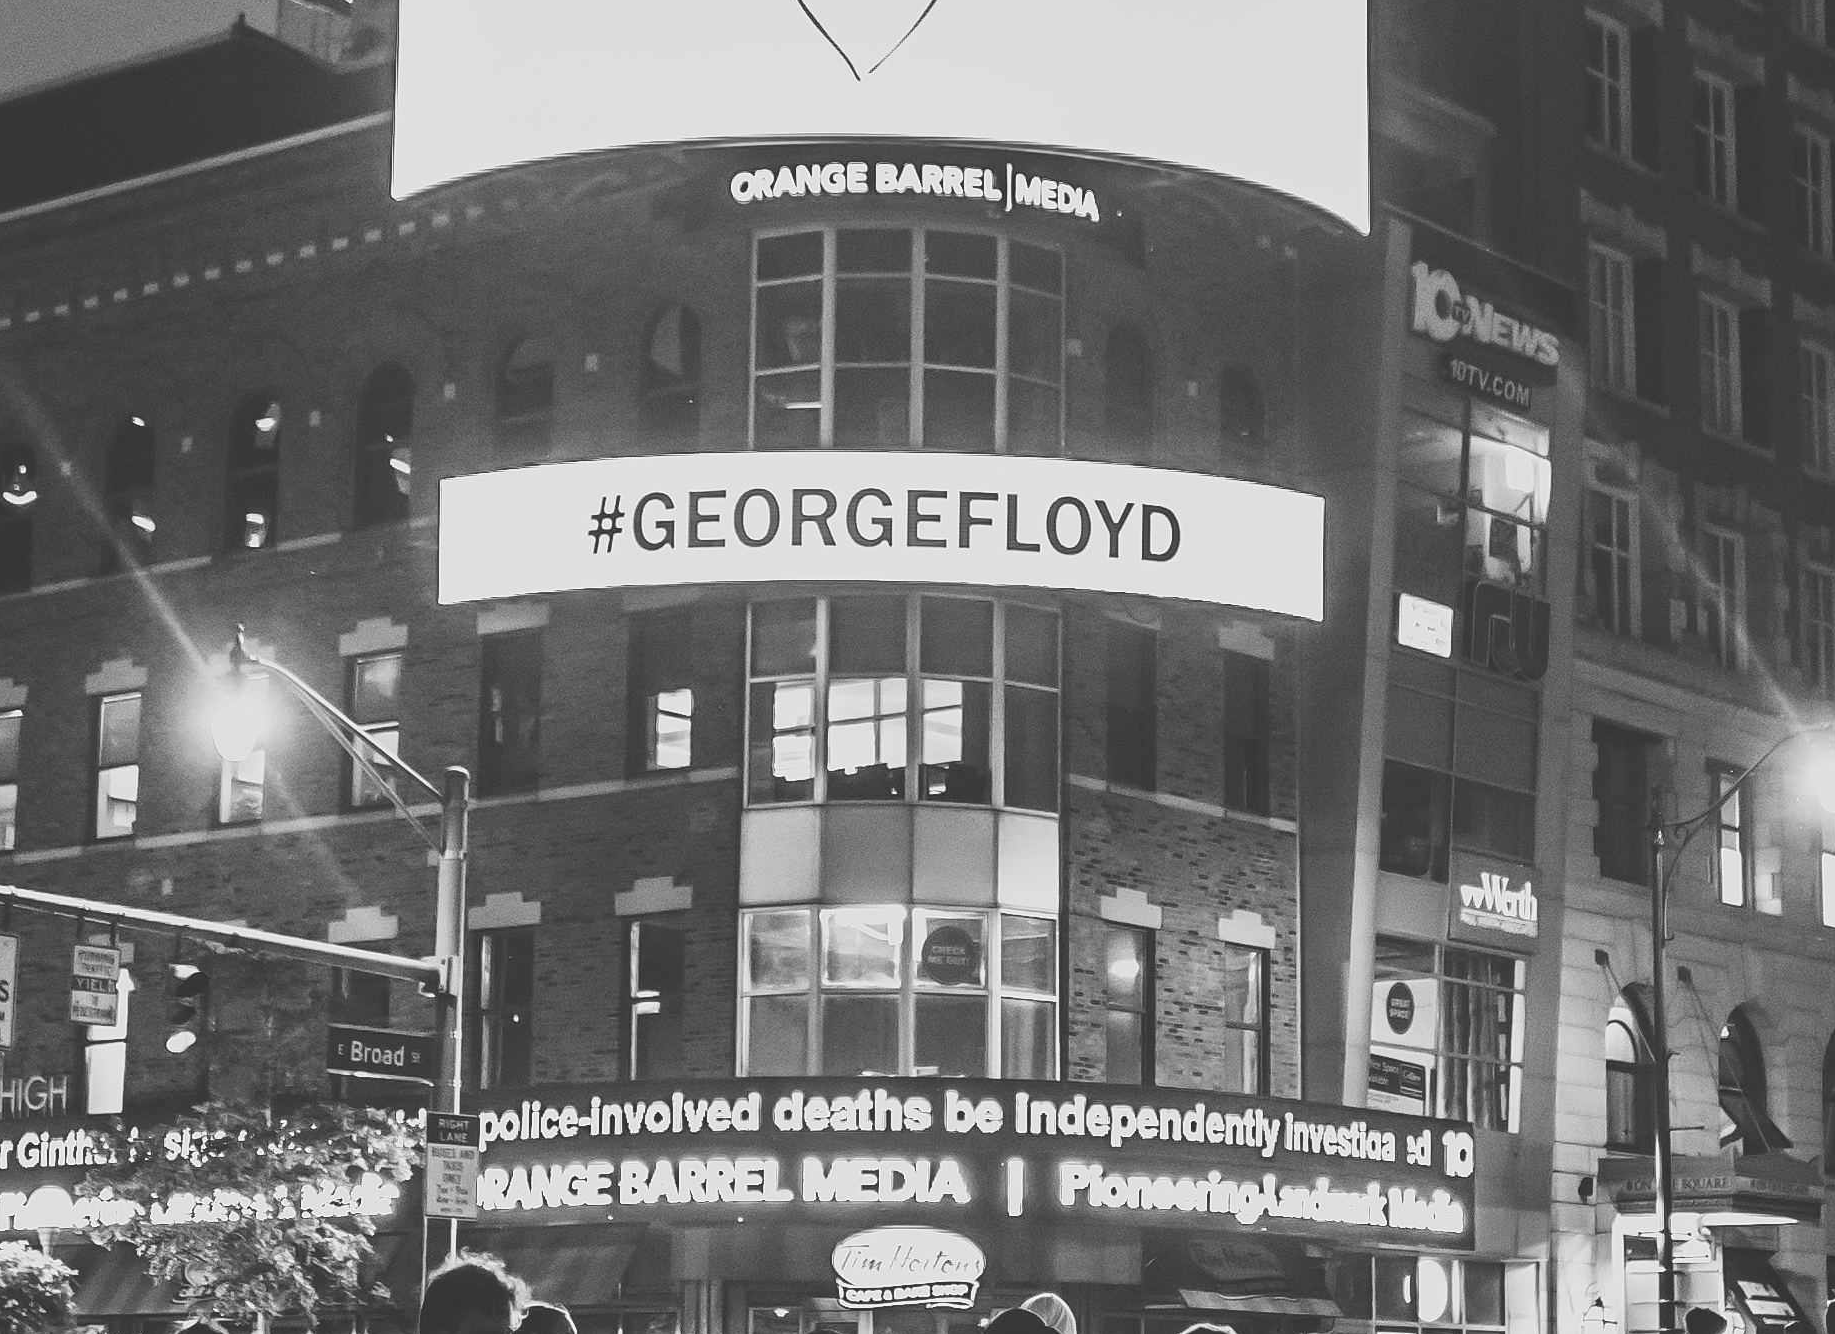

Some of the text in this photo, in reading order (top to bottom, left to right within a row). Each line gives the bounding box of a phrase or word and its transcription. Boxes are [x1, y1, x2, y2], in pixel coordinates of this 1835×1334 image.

[731, 162, 1100, 222] ORANGE BARREL MEDIA
[1412, 261, 1463, 341] 10
[1462, 295, 1561, 365] NEWS
[1451, 359, 1531, 407] 10TV.COM
[587, 487, 1182, 563] #GEORGEFLOYD
[1480, 872, 1538, 920] Werth
[338, 1044, 345, 1055] E
[350, 1040, 405, 1067] Broad
[0, 1075, 68, 1118] HIGH
[478, 1091, 762, 1153] police-involved
[773, 1088, 933, 1133] deaths
[945, 1090, 1003, 1134] be
[438, 1118, 470, 1131] RIGHT
[440, 1131, 469, 1144] LANE
[477, 1161, 615, 1210] RANGE
[618, 1157, 794, 1205] BARREL
[801, 1156, 971, 1204] MEDIA
[1058, 1160, 1261, 1225] Pioneering
[838, 1244, 883, 1272] Tim
